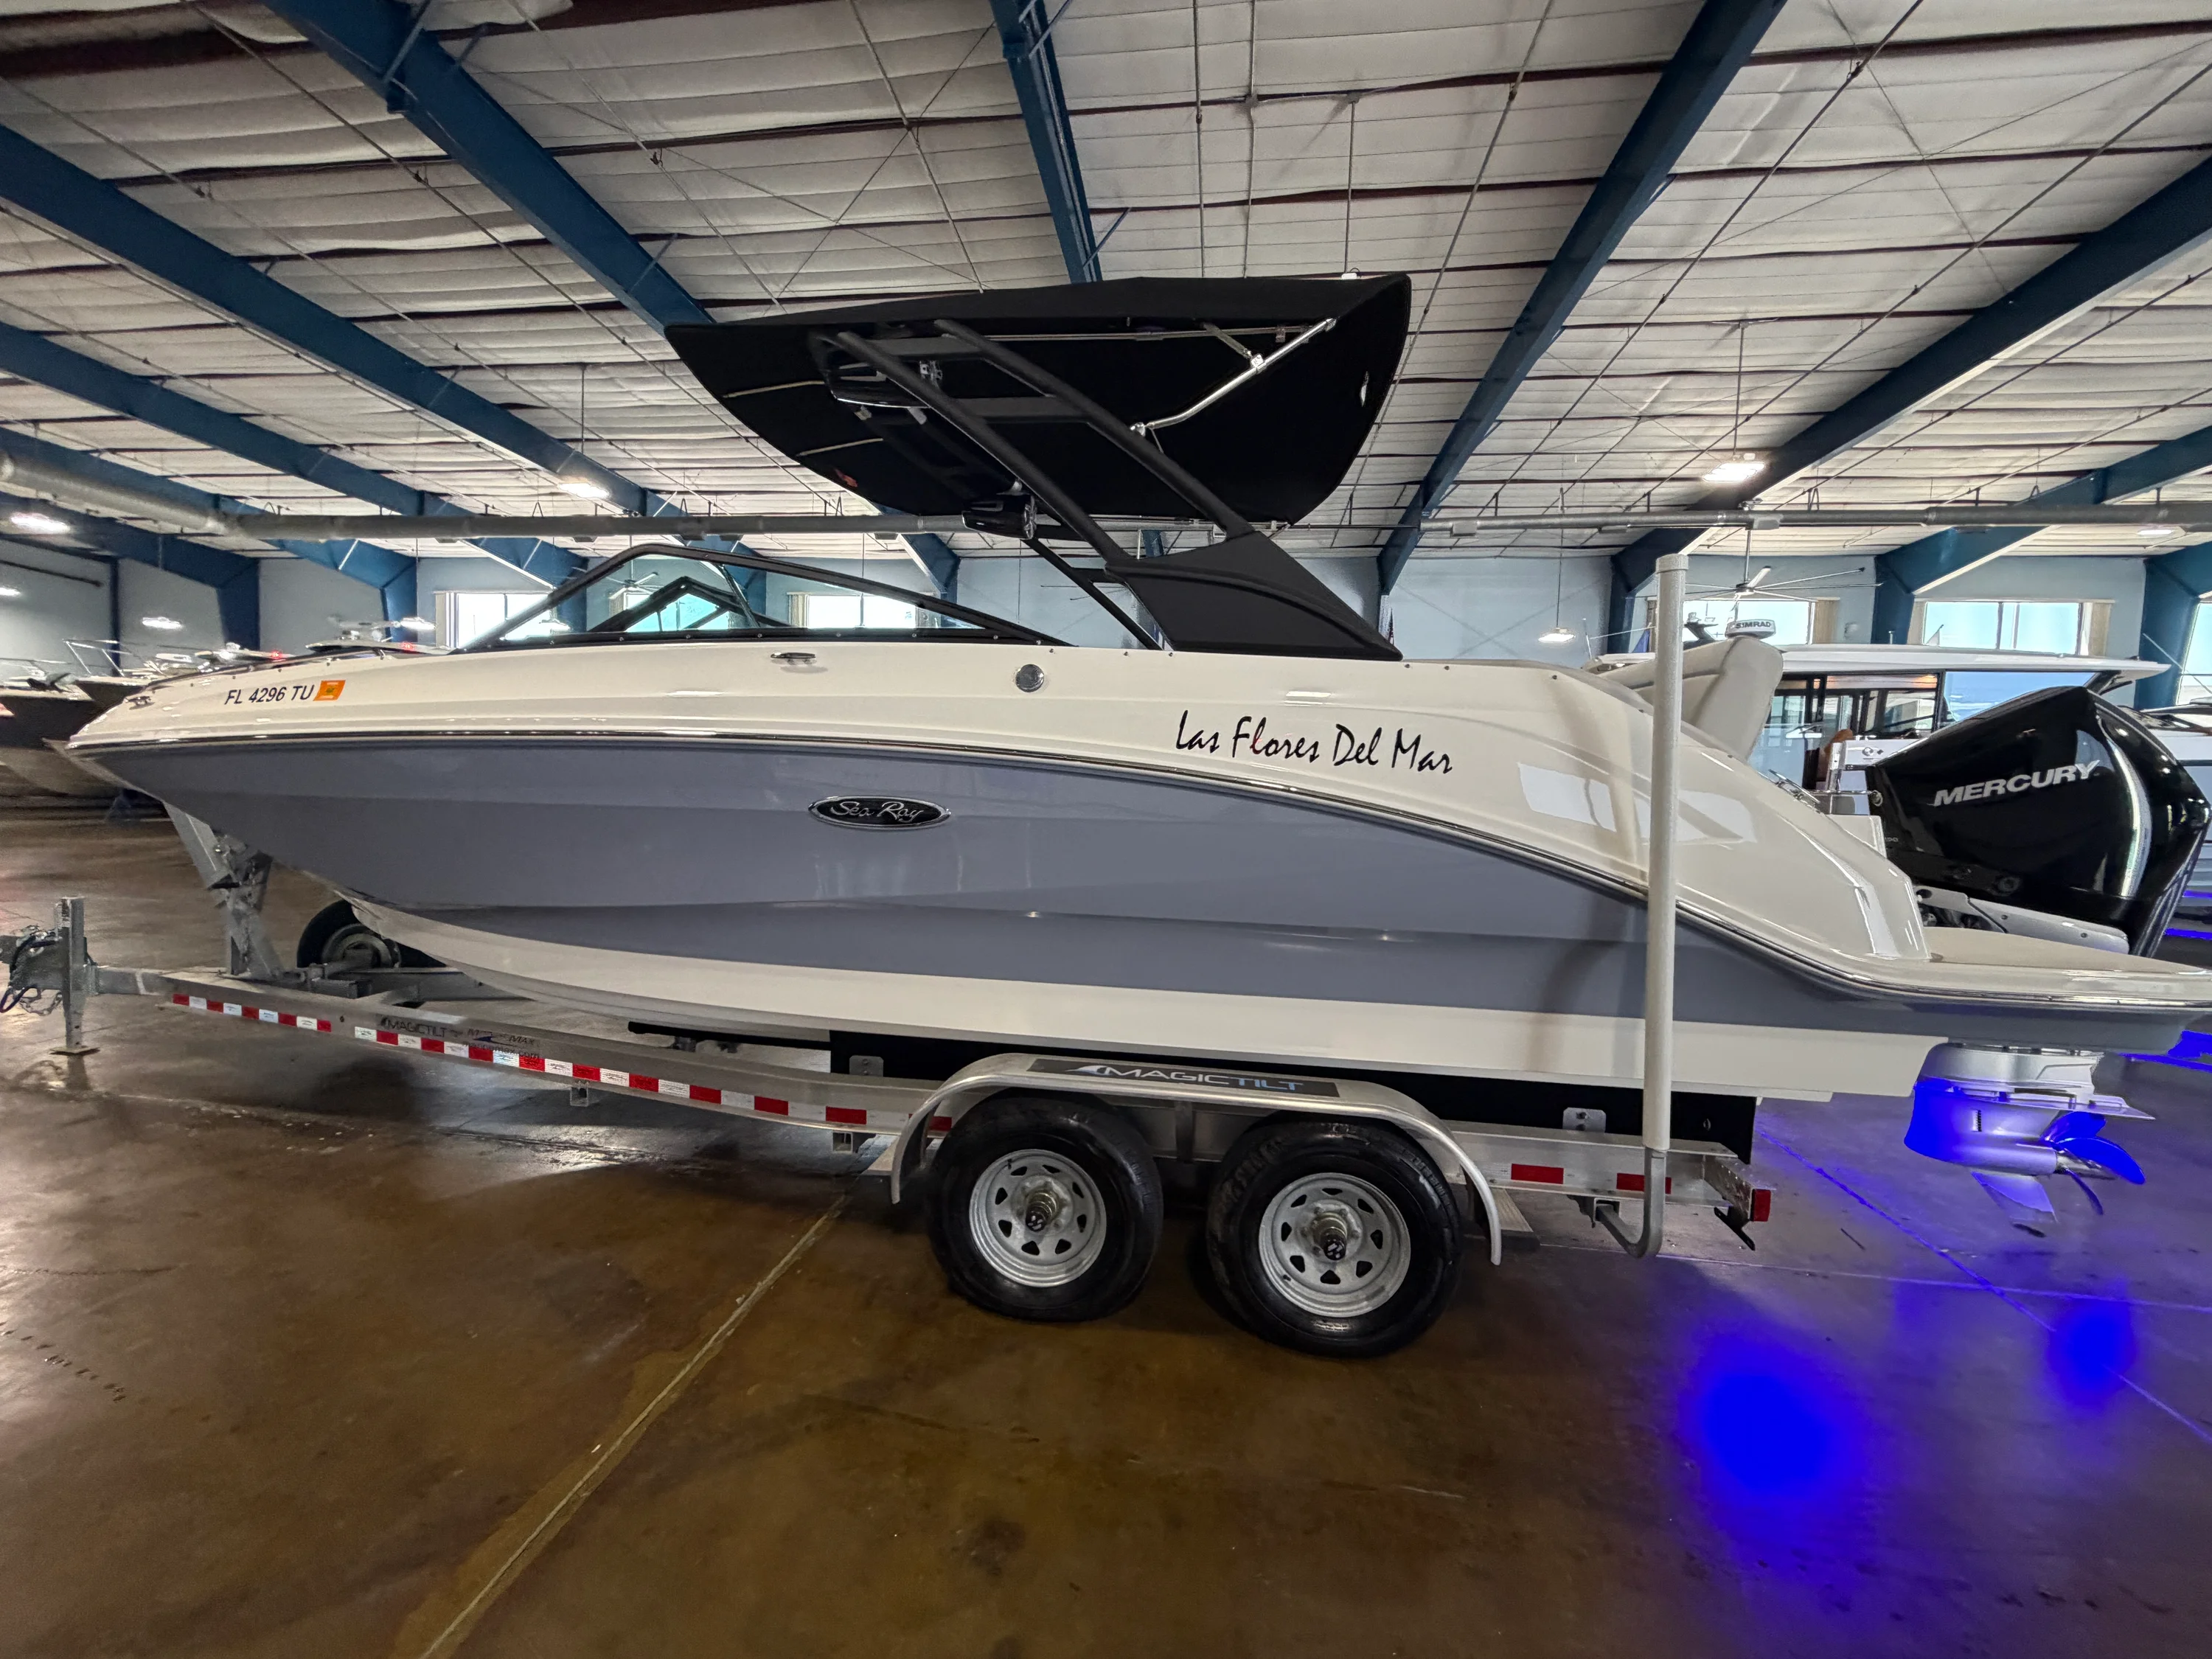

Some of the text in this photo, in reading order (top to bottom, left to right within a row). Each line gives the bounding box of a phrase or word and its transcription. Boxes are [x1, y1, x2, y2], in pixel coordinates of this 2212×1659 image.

[1735, 621, 1771, 629] SIMRAD
[224, 689, 242, 705] FL
[248, 686, 287, 703] 4296
[291, 684, 315, 700] TU
[1175, 709, 1453, 774] Las Flores Del Mar
[1933, 759, 2101, 807] MERCURY
[830, 801, 924, 824] Sea Ray
[1104, 1065, 1304, 1091] MAGICTILT
